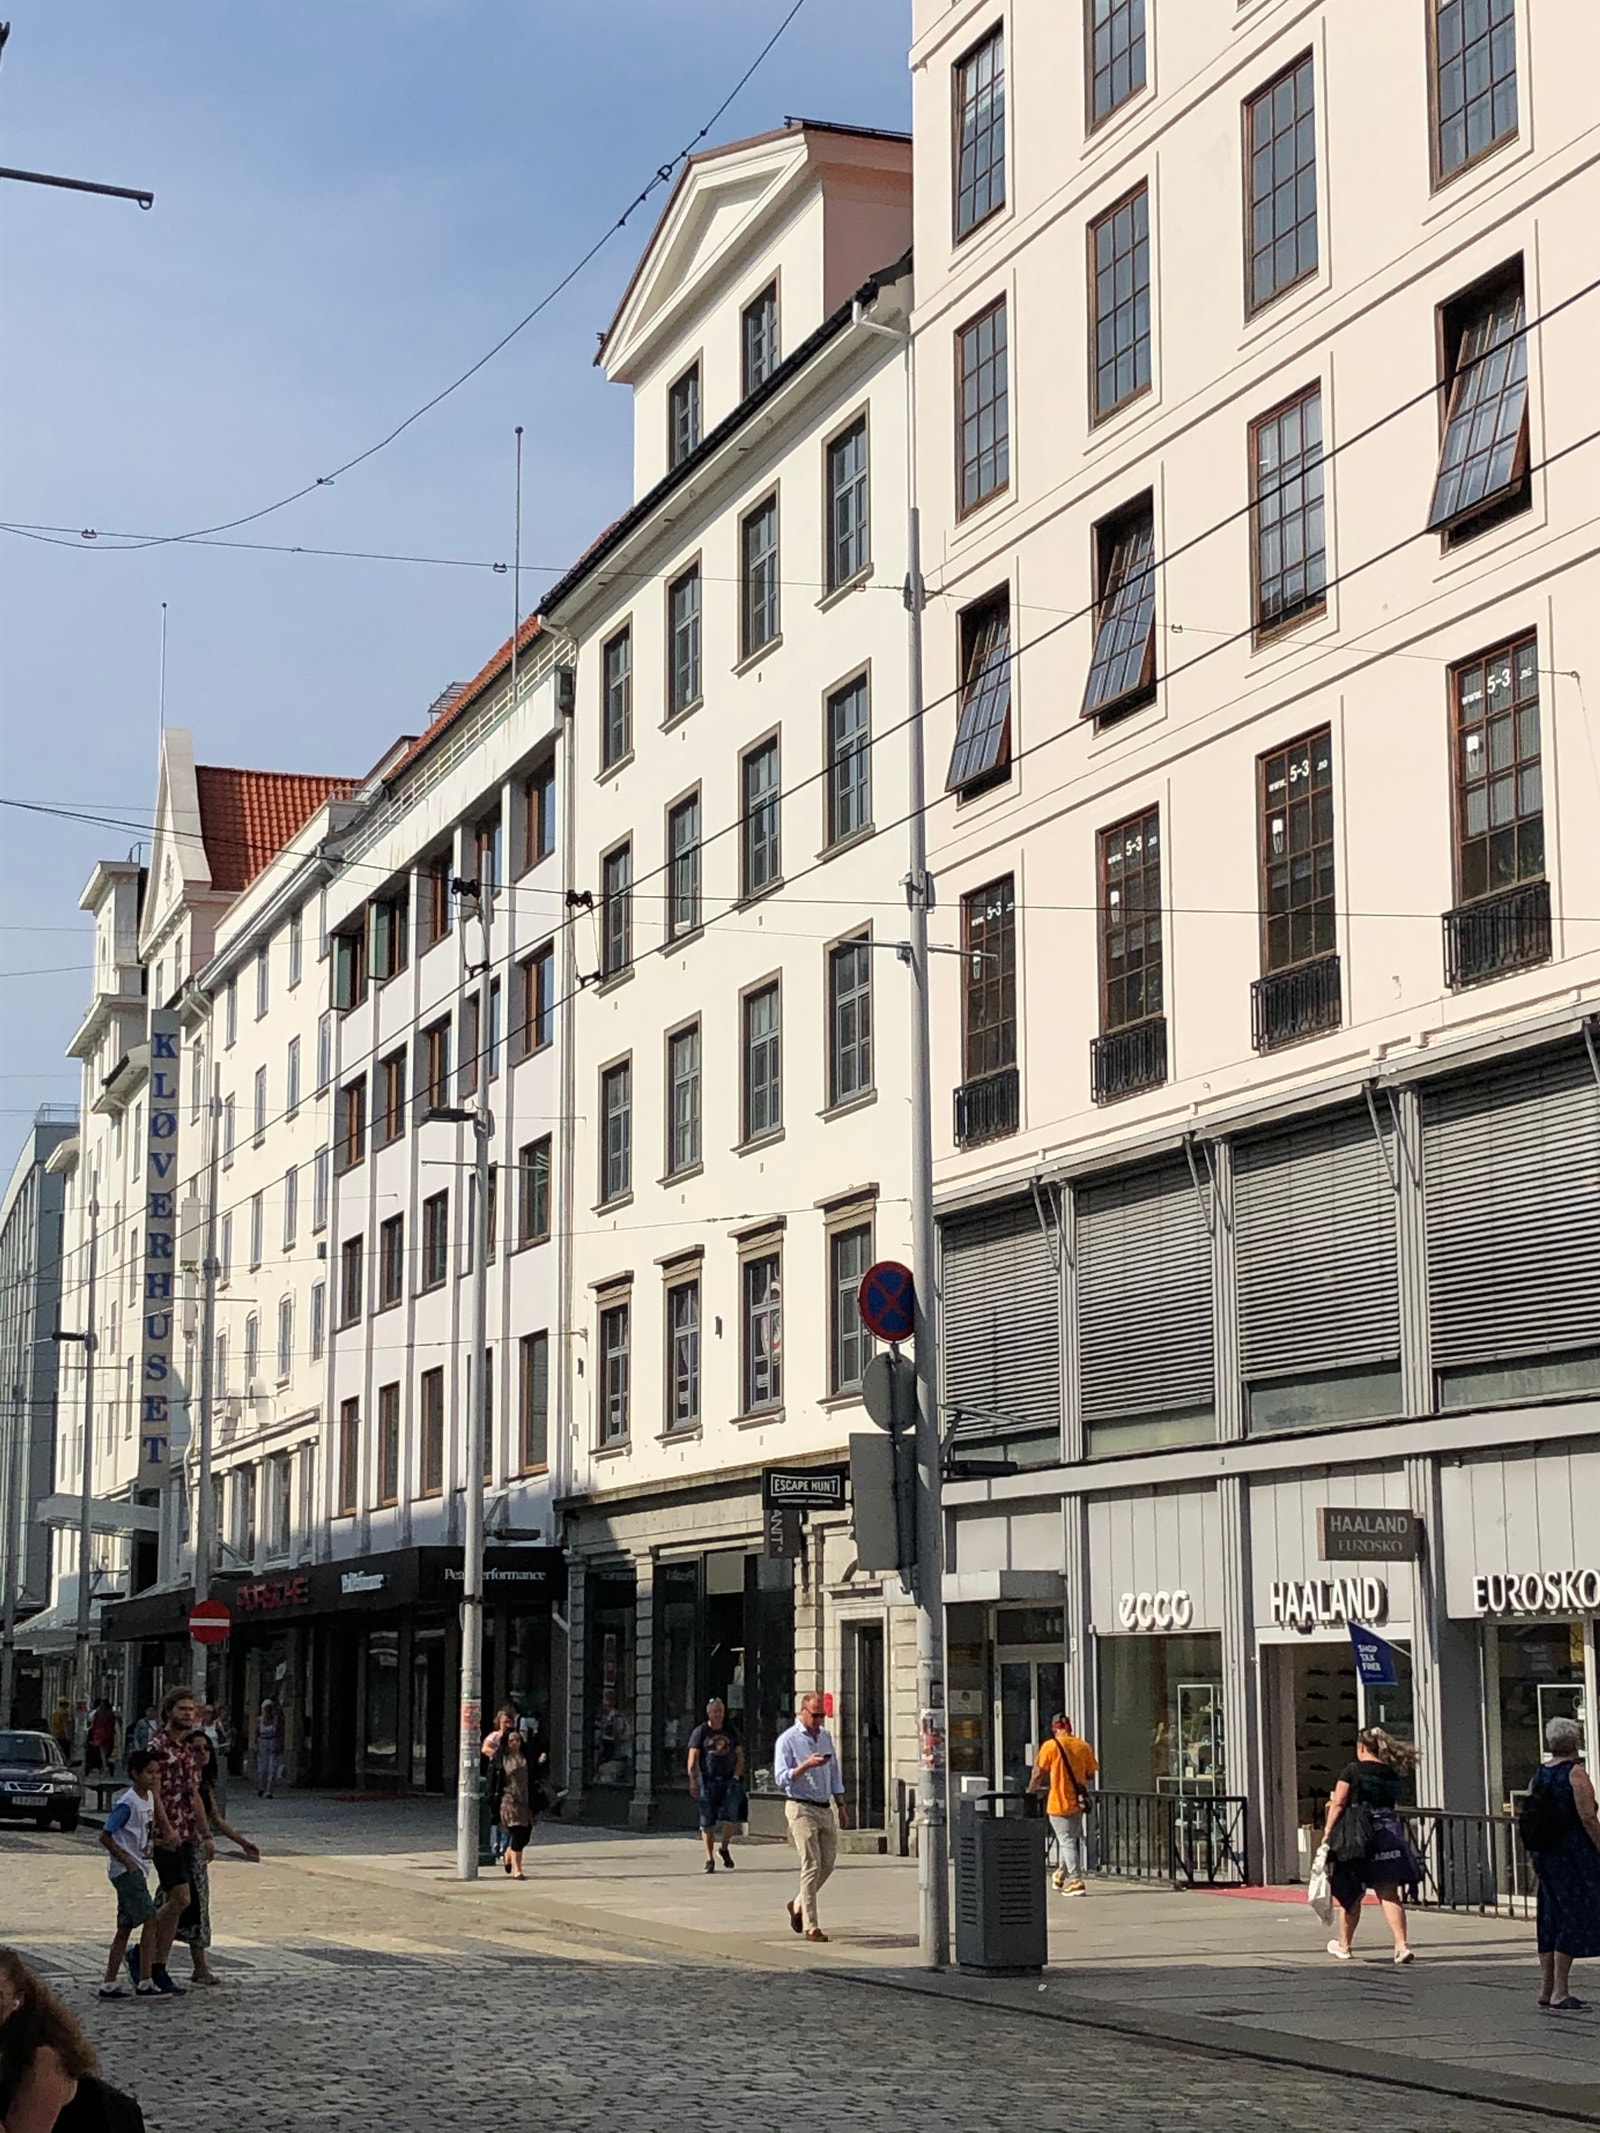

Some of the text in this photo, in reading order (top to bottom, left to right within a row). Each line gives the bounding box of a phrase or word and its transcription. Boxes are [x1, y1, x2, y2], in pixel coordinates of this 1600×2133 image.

[1487, 669, 1511, 694] 5-3
[1290, 760, 1309, 782] 5-3
[1126, 836, 1142, 856] 5-3
[142, 1032, 179, 1464] KLØVERHUSET
[774, 1479, 837, 1492] ESCAPE HUNT
[771, 1510, 784, 1545] ANIT
[1330, 1515, 1408, 1534] HAALAND
[1338, 1540, 1403, 1552] EUROSKO
[444, 1568, 546, 1580] Pea erformance
[1270, 1577, 1384, 1622] HAALAND
[1473, 1569, 1600, 1612] EUROSKO
